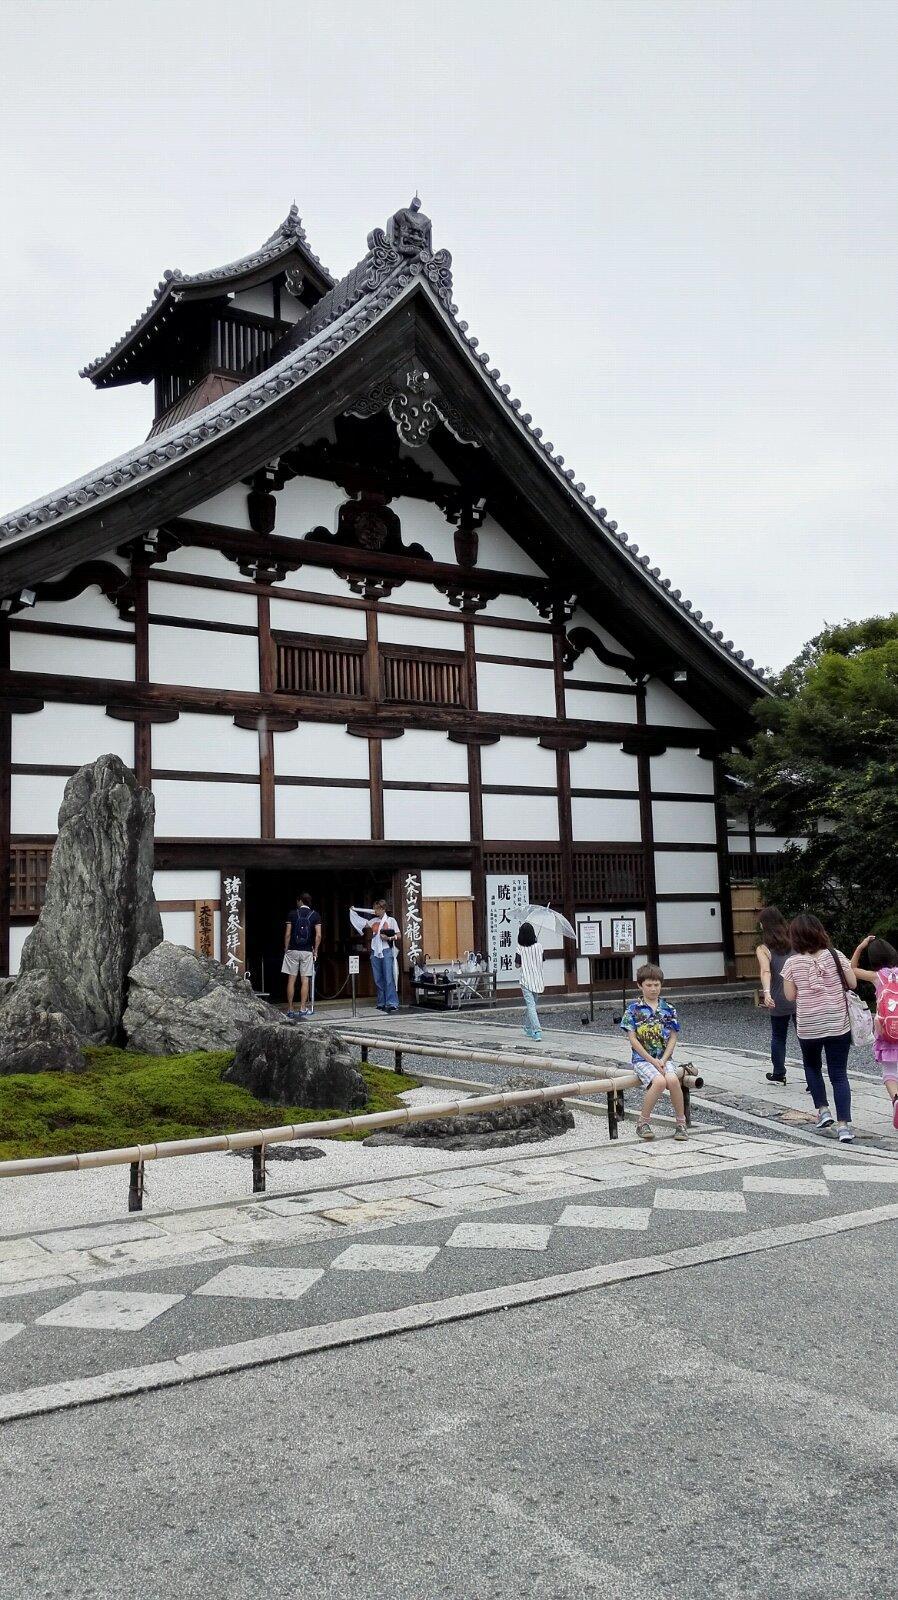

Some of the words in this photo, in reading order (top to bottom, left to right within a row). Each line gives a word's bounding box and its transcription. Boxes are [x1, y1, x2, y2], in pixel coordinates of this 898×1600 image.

[404, 873, 422, 965] 大本山天龍寺
[497, 884, 513, 971] 暁天講座
